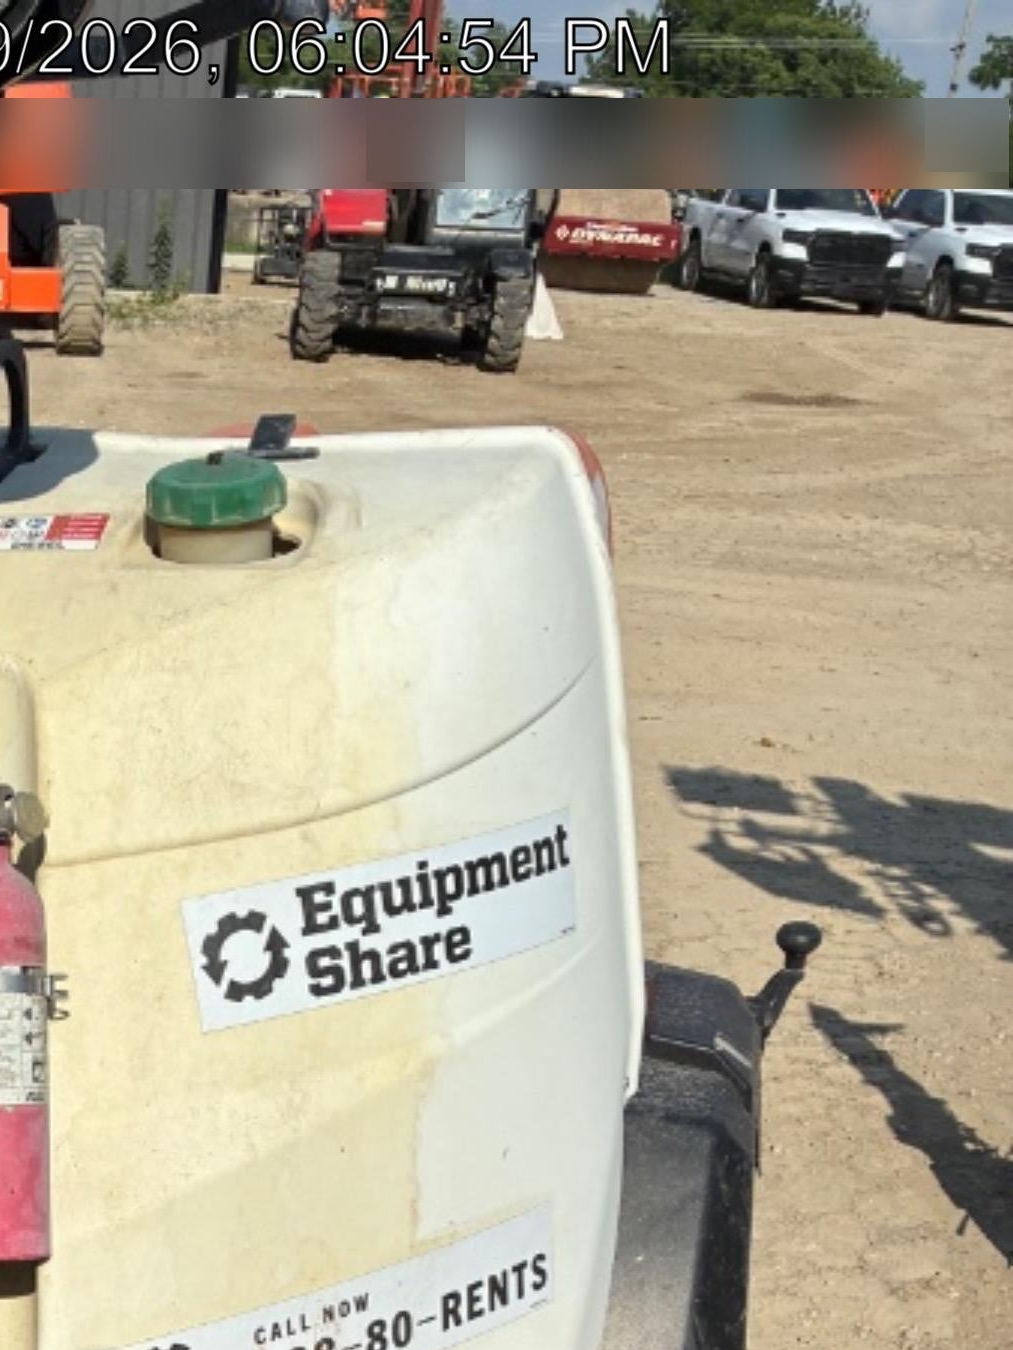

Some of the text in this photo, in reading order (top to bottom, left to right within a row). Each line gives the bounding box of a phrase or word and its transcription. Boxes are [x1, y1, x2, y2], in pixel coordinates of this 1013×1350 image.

[295, 823, 570, 936] Equipment
[305, 925, 472, 998] Share
[253, 1292, 370, 1345] CALL NOW
